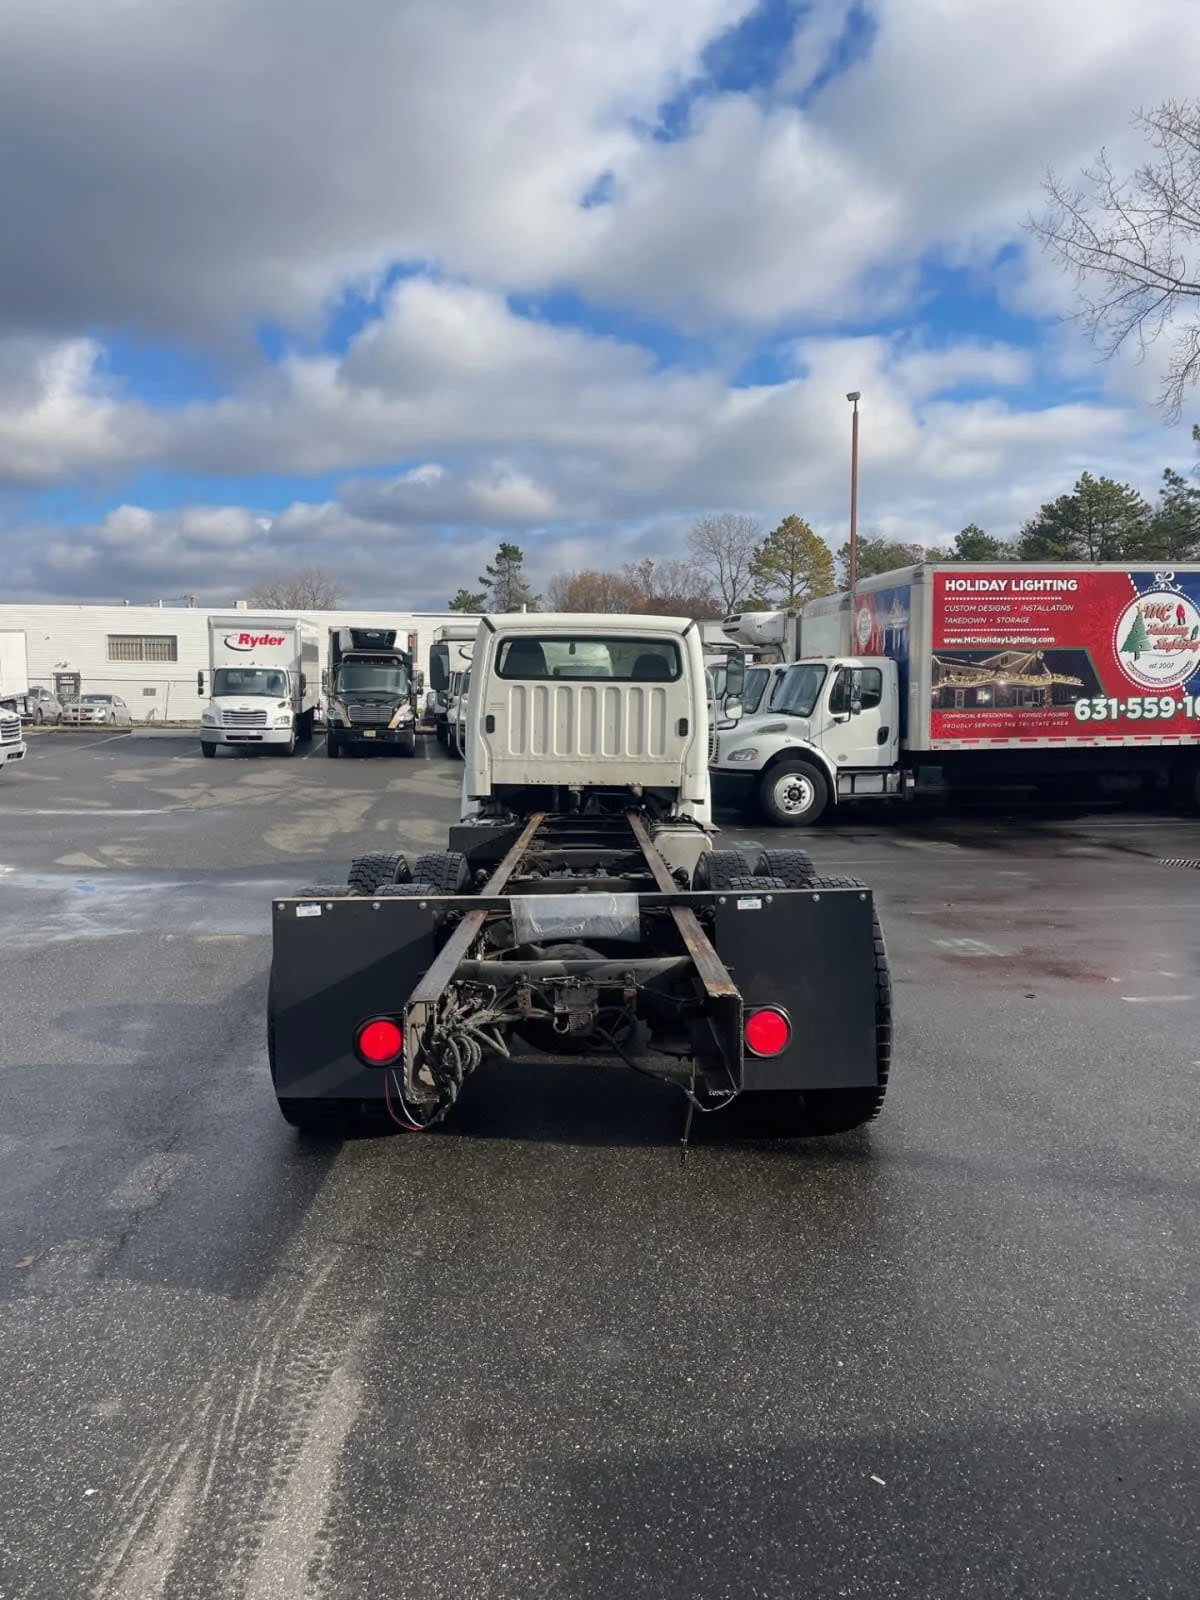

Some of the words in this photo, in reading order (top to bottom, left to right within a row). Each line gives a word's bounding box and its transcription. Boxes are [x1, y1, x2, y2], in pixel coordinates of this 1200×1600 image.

[945, 579, 1008, 591] HOLIDAY
[1011, 579, 1078, 591] LIGHTING
[944, 604, 976, 612] CUSTOM
[977, 604, 1011, 612] DESIGNS
[1144, 602, 1174, 623] MC
[996, 616, 1030, 624] STORAGE
[1146, 624, 1189, 638] Holiday
[238, 633, 286, 648] Ryder
[943, 636, 1055, 645] www.MCHolidayLighting.com
